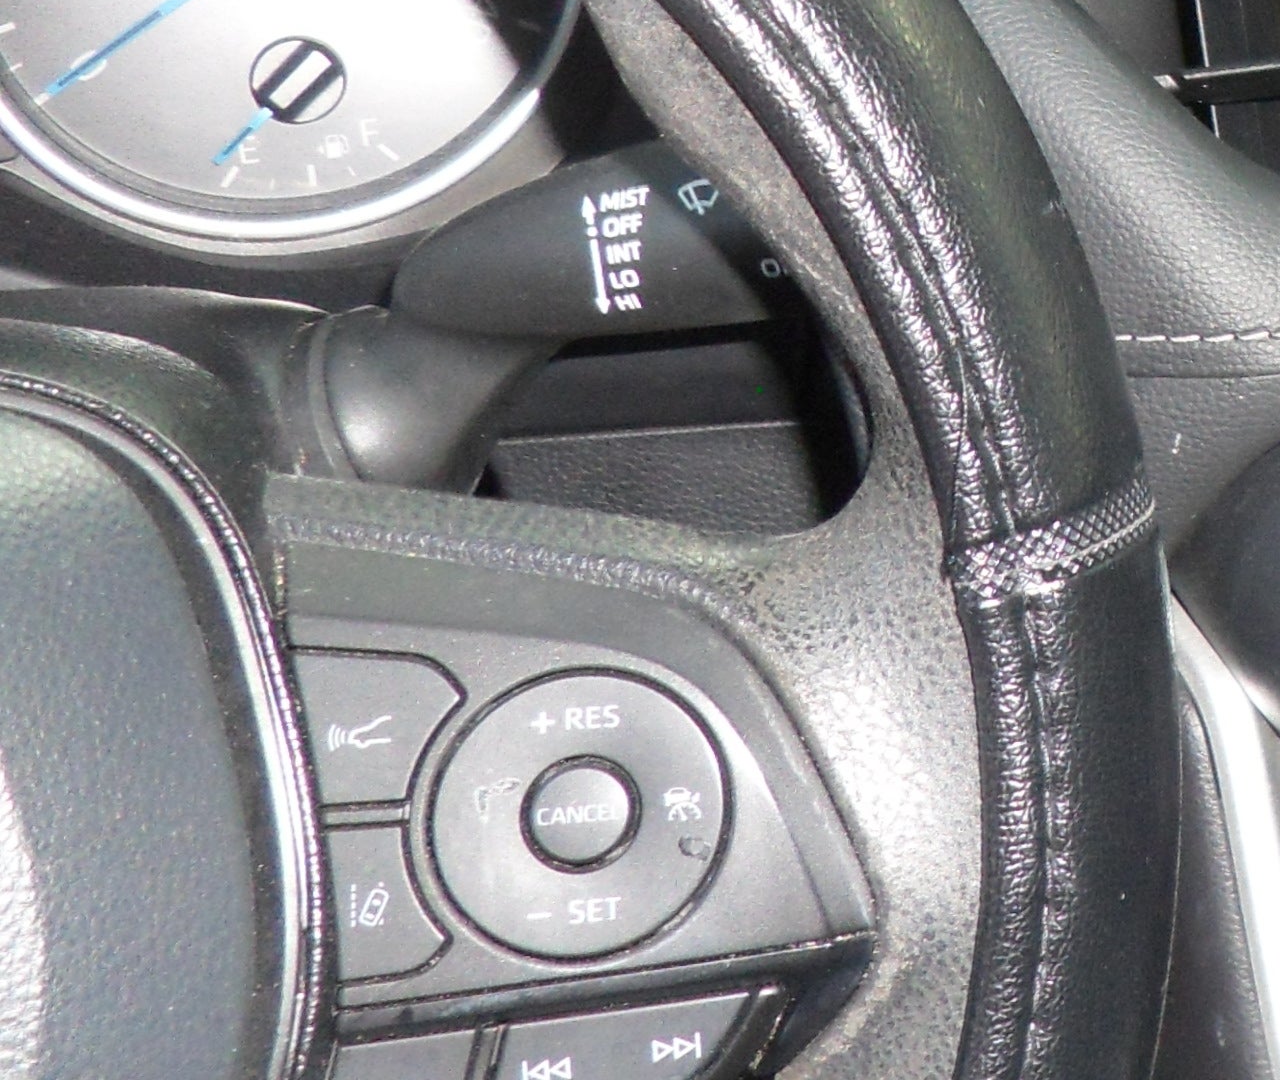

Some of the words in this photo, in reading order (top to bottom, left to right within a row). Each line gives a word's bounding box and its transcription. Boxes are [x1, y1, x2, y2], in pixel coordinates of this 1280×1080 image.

[360, 119, 386, 147] F
[240, 136, 261, 165] E
[599, 184, 650, 214] MIST
[600, 212, 644, 239] OFF
[605, 241, 642, 265] INT
[608, 269, 640, 290] LO
[613, 294, 642, 312] HI
[564, 705, 622, 731] RES
[536, 804, 620, 826] CANCEL
[568, 896, 622, 924] SET
